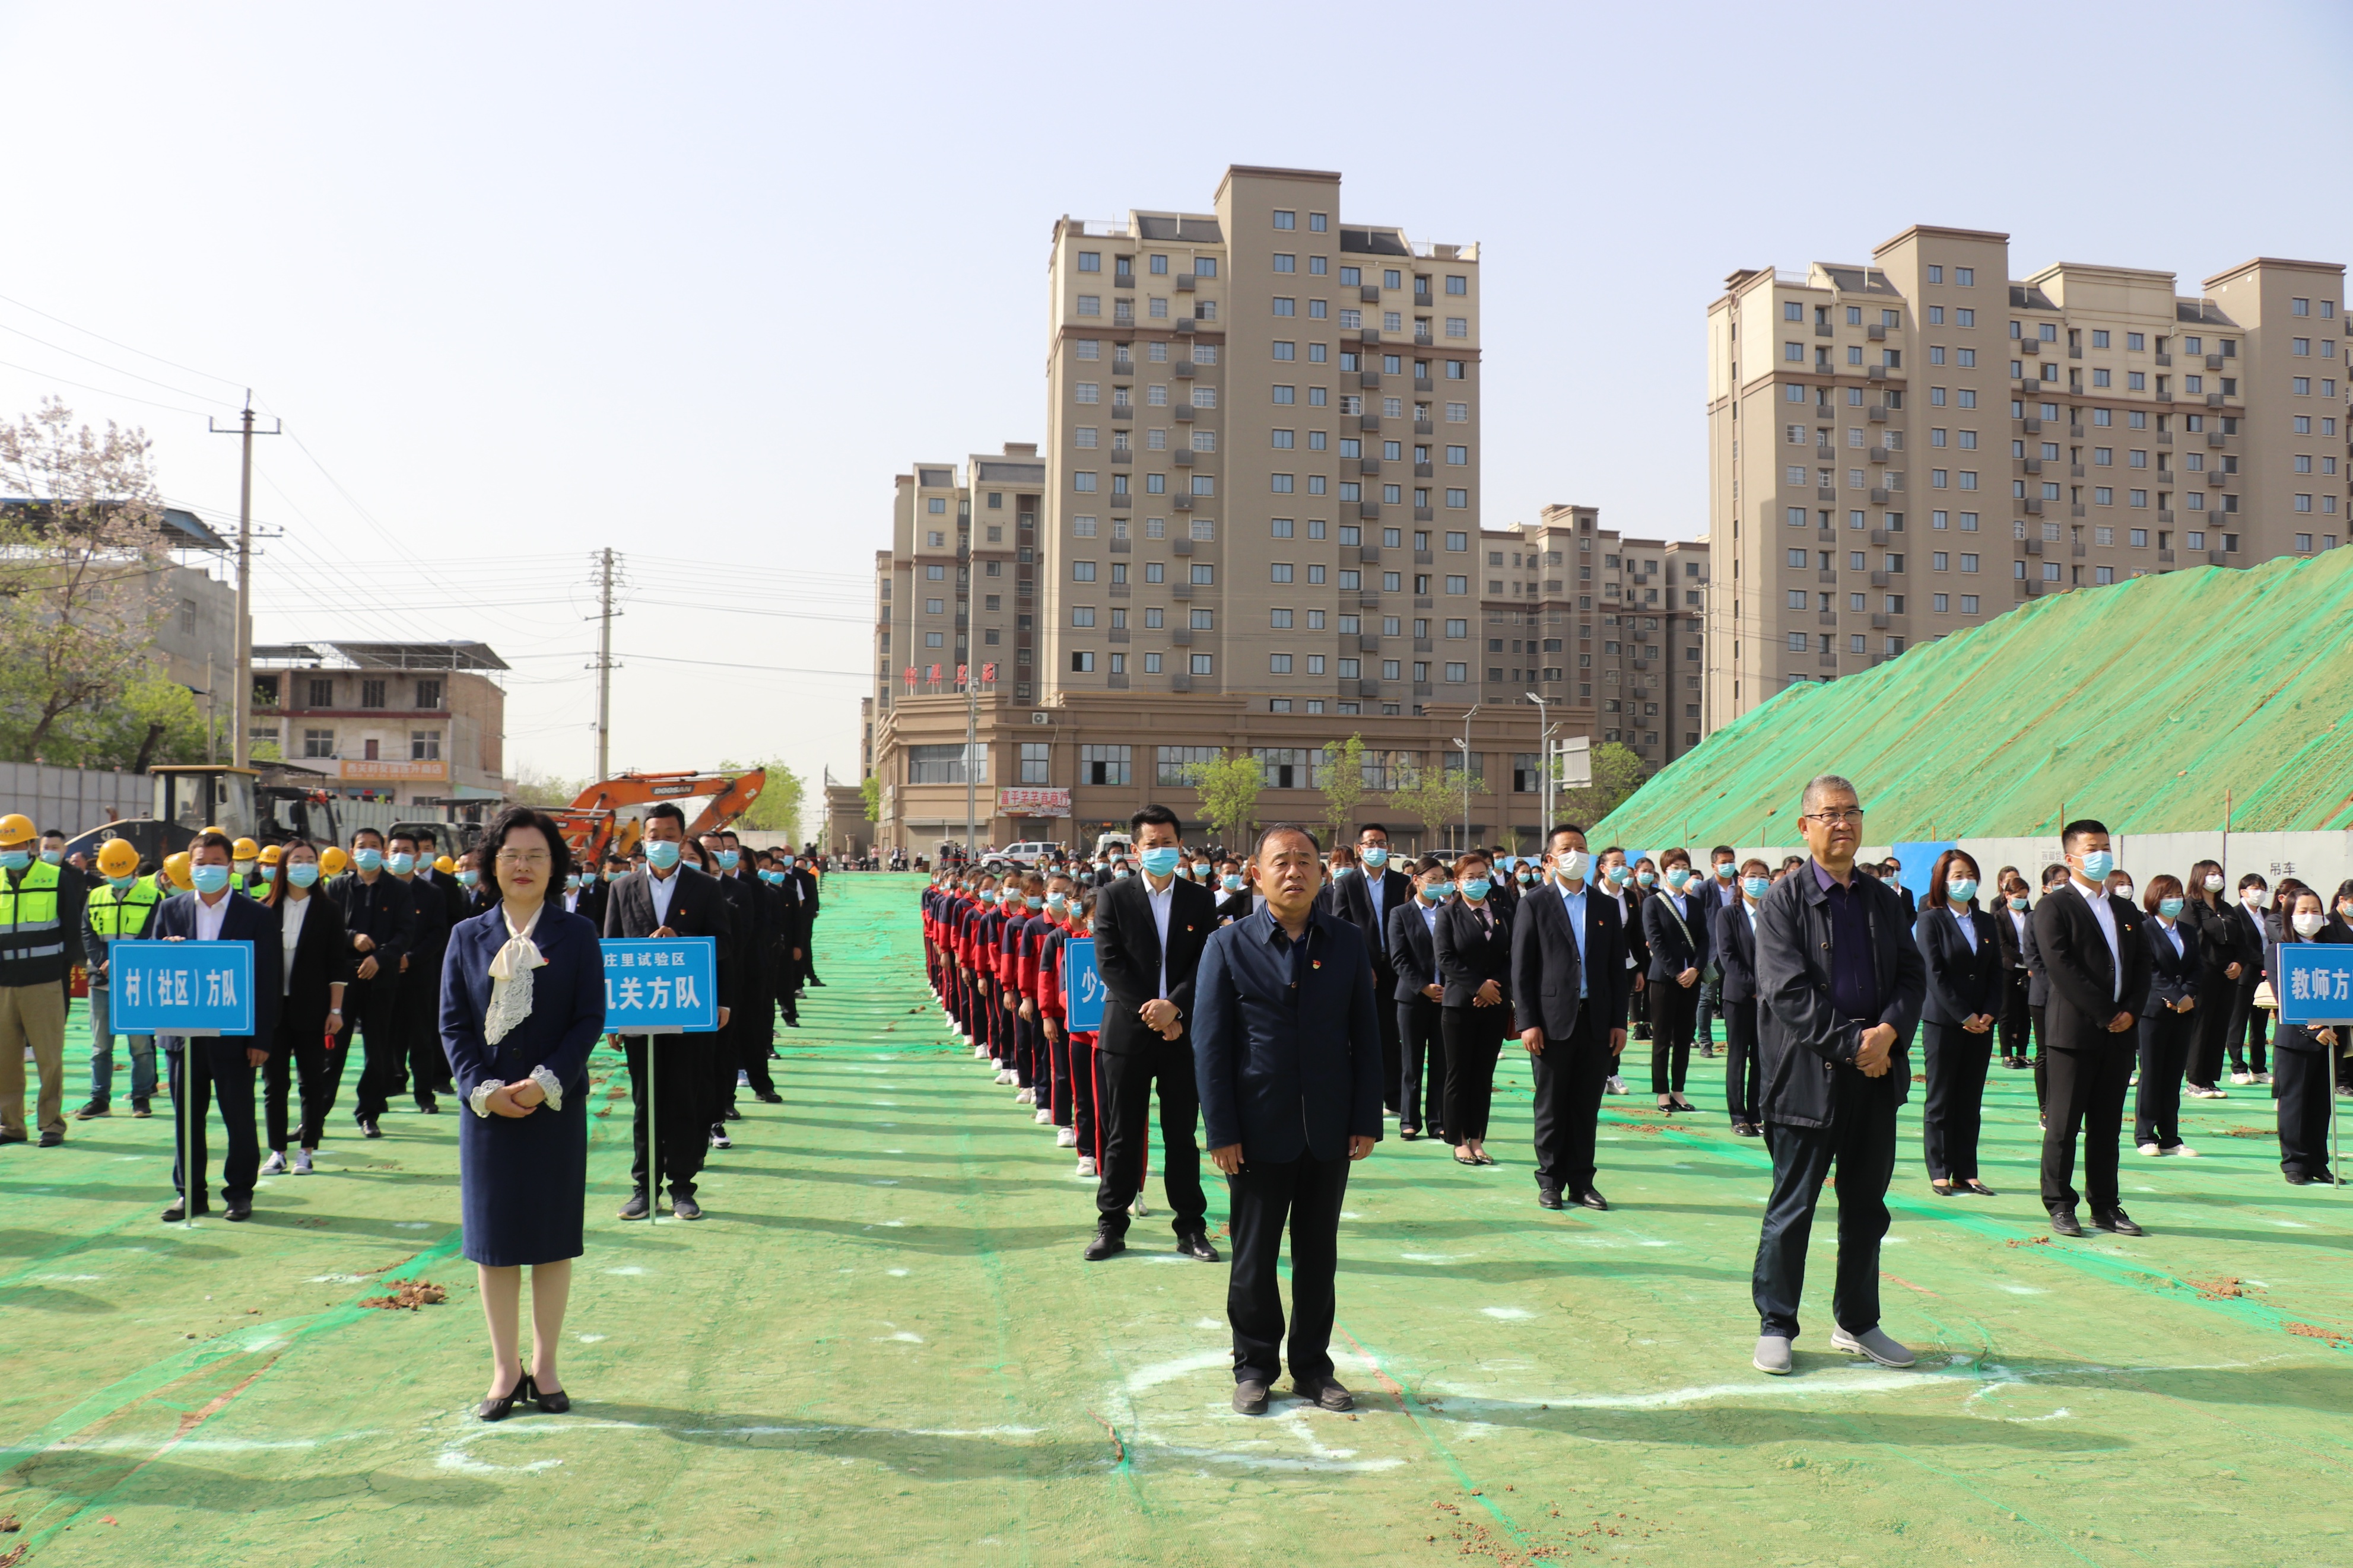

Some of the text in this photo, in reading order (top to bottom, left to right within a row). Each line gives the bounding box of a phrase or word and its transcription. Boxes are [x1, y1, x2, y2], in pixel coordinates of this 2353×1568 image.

[654, 786, 692, 794] DOOSAN
[2271, 861, 2295, 876] 吊车
[604, 952, 685, 967] 庄里试验区
[125, 968, 237, 1006] 村（社区）方队
[1081, 966, 1107, 1003] 少
[2291, 967, 2353, 1000] 教师方
